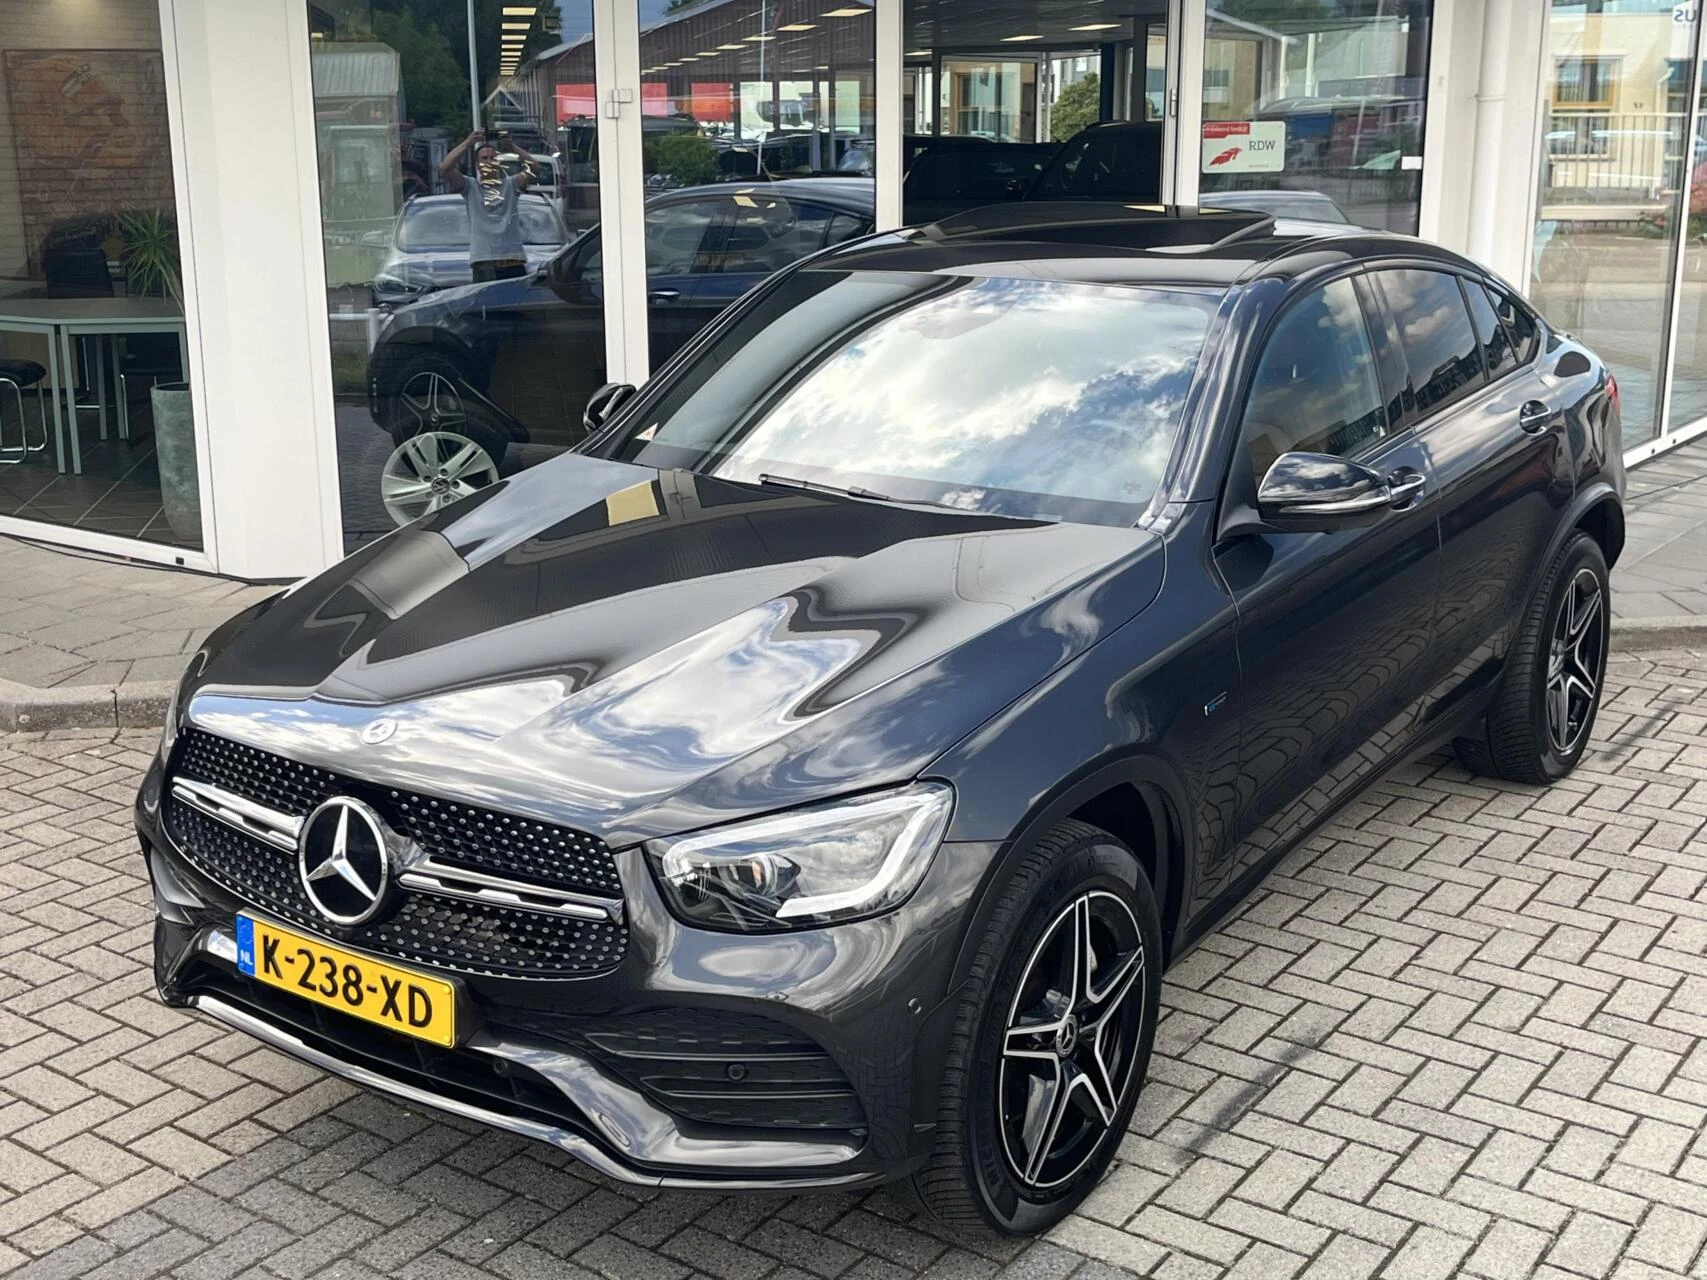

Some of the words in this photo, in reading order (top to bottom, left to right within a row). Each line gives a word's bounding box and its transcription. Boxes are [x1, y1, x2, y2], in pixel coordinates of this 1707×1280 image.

[1249, 140, 1276, 151] RDW
[240, 949, 254, 966] NL
[262, 933, 433, 1028] K-238-XD
